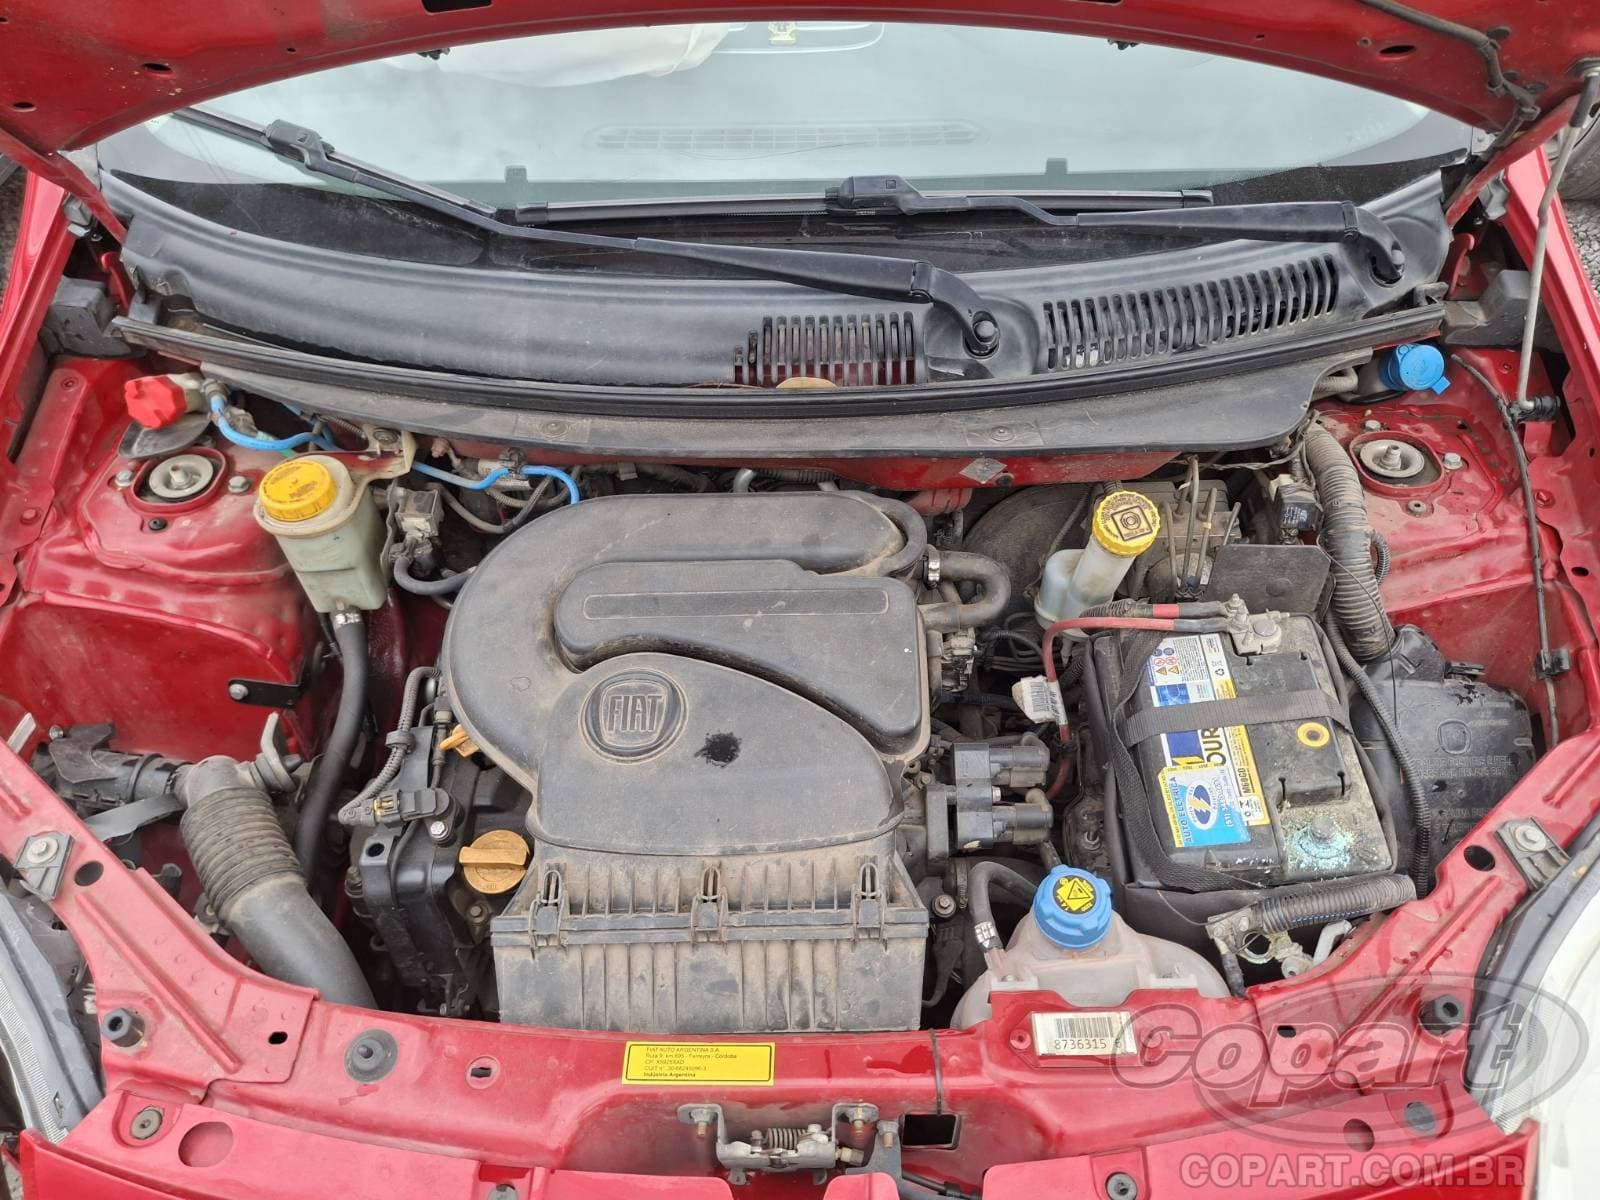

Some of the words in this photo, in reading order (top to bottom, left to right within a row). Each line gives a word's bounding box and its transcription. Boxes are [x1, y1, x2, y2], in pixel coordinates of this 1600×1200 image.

[606, 694, 663, 732] FIAT
[1201, 727, 1227, 766] OUR
[1168, 776, 1186, 818] ELETRICA
[1179, 820, 1192, 843] AUTO
[1054, 1038, 1107, 1050] 8736315
